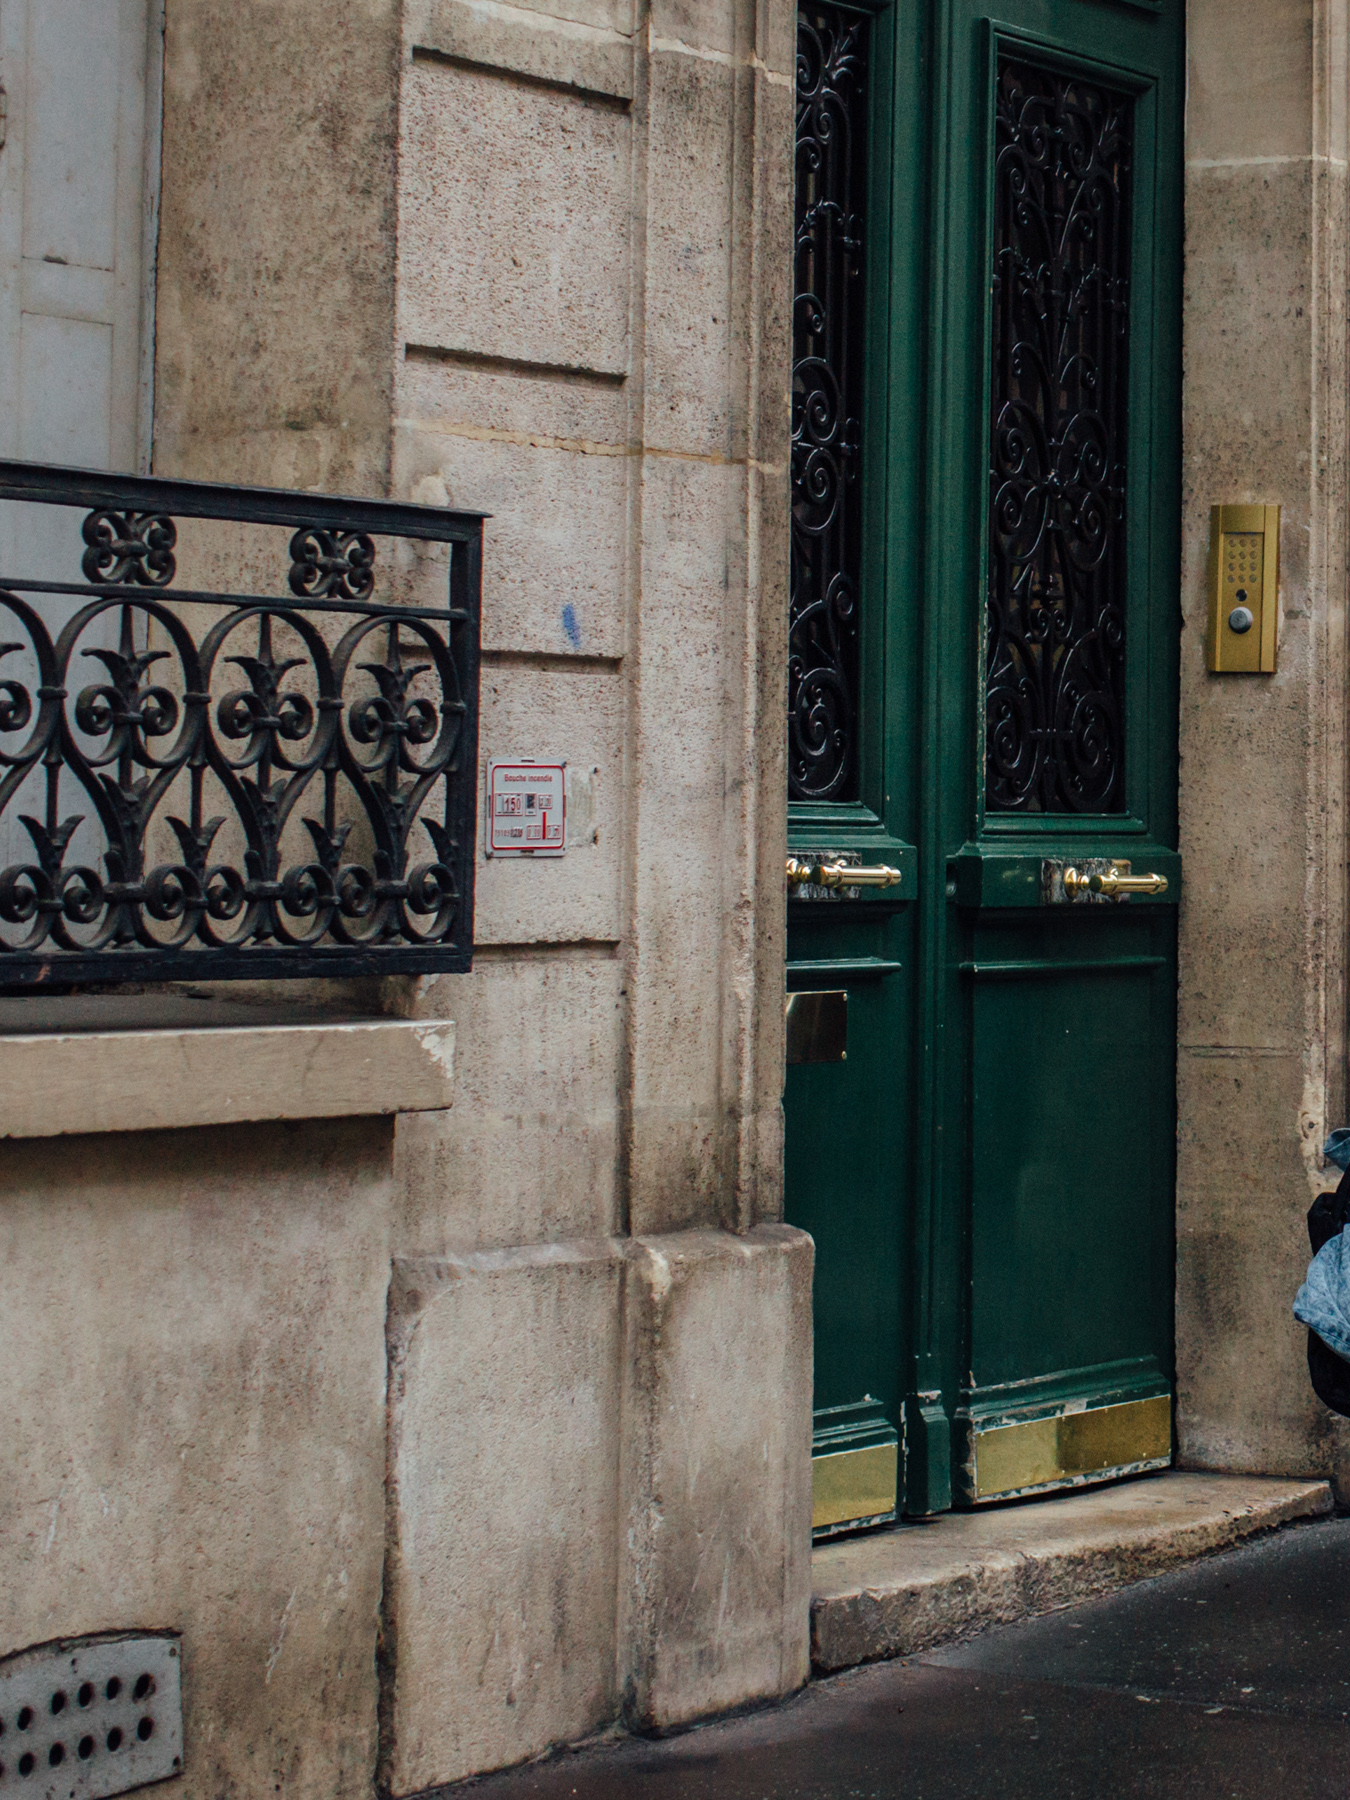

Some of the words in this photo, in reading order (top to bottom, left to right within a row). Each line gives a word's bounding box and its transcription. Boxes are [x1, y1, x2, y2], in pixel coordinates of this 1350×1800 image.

[504, 774, 526, 782] Bouche
[528, 774, 553, 782] incendie
[504, 797, 521, 811] 150
